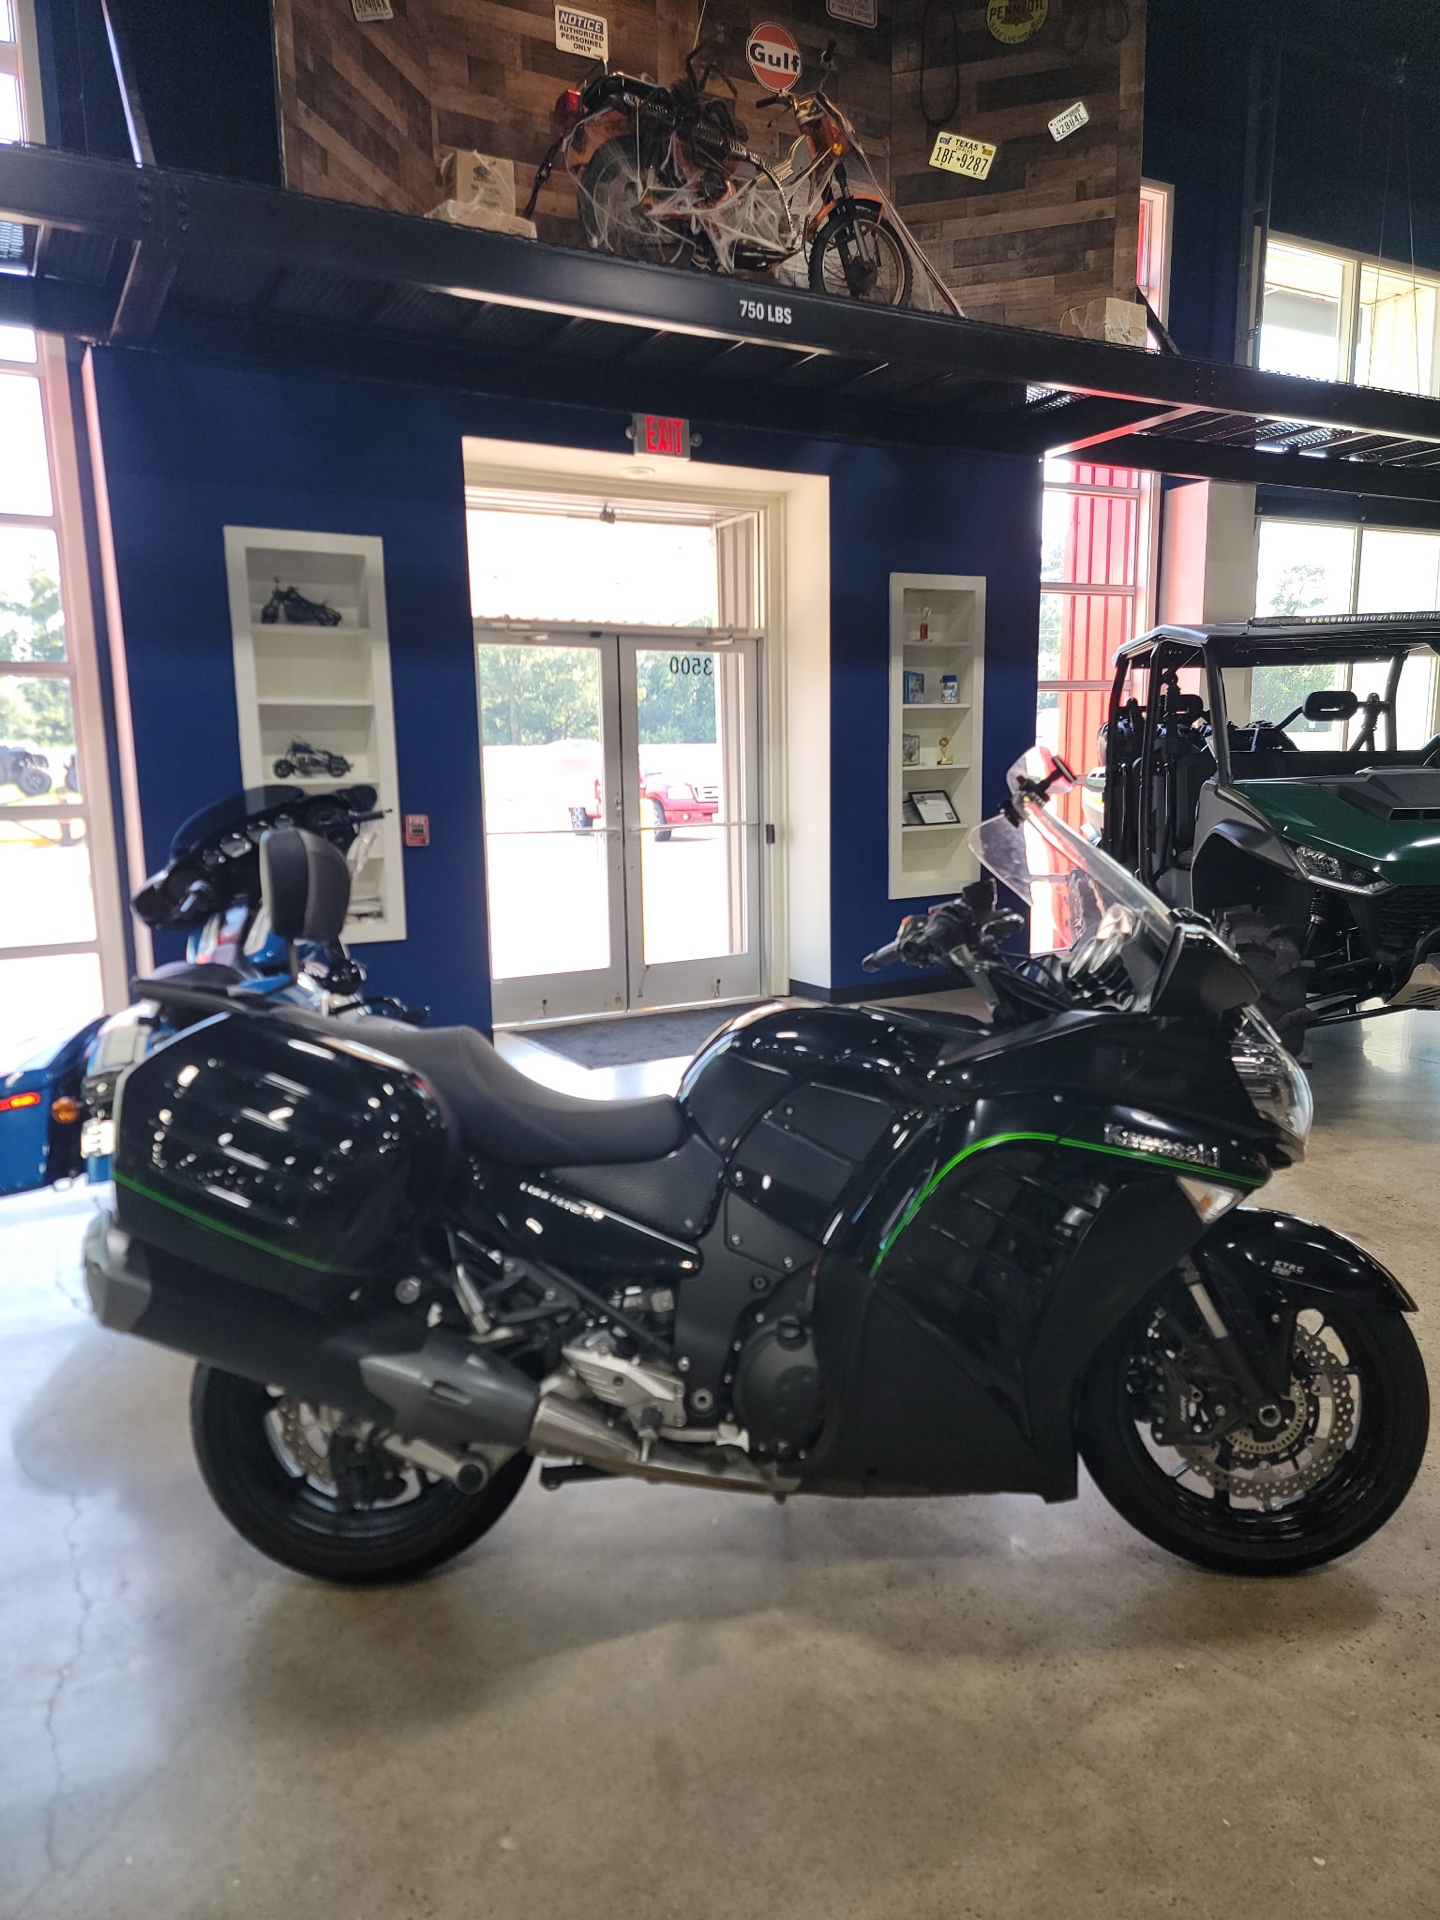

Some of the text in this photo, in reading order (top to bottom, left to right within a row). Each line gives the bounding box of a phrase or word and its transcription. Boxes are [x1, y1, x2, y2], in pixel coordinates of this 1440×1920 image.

[560, 11, 603, 33] NOTICE
[989, 22, 1004, 38] SAFE
[559, 24, 604, 42] AUTHORIZED
[560, 32, 603, 49] PERSONNEL
[573, 43, 592, 53] ONLY
[749, 42, 800, 73] Gulf
[955, 139, 979, 151] TEXAS
[739, 299, 792, 325] 750 LBS
[645, 415, 684, 455] EXIT
